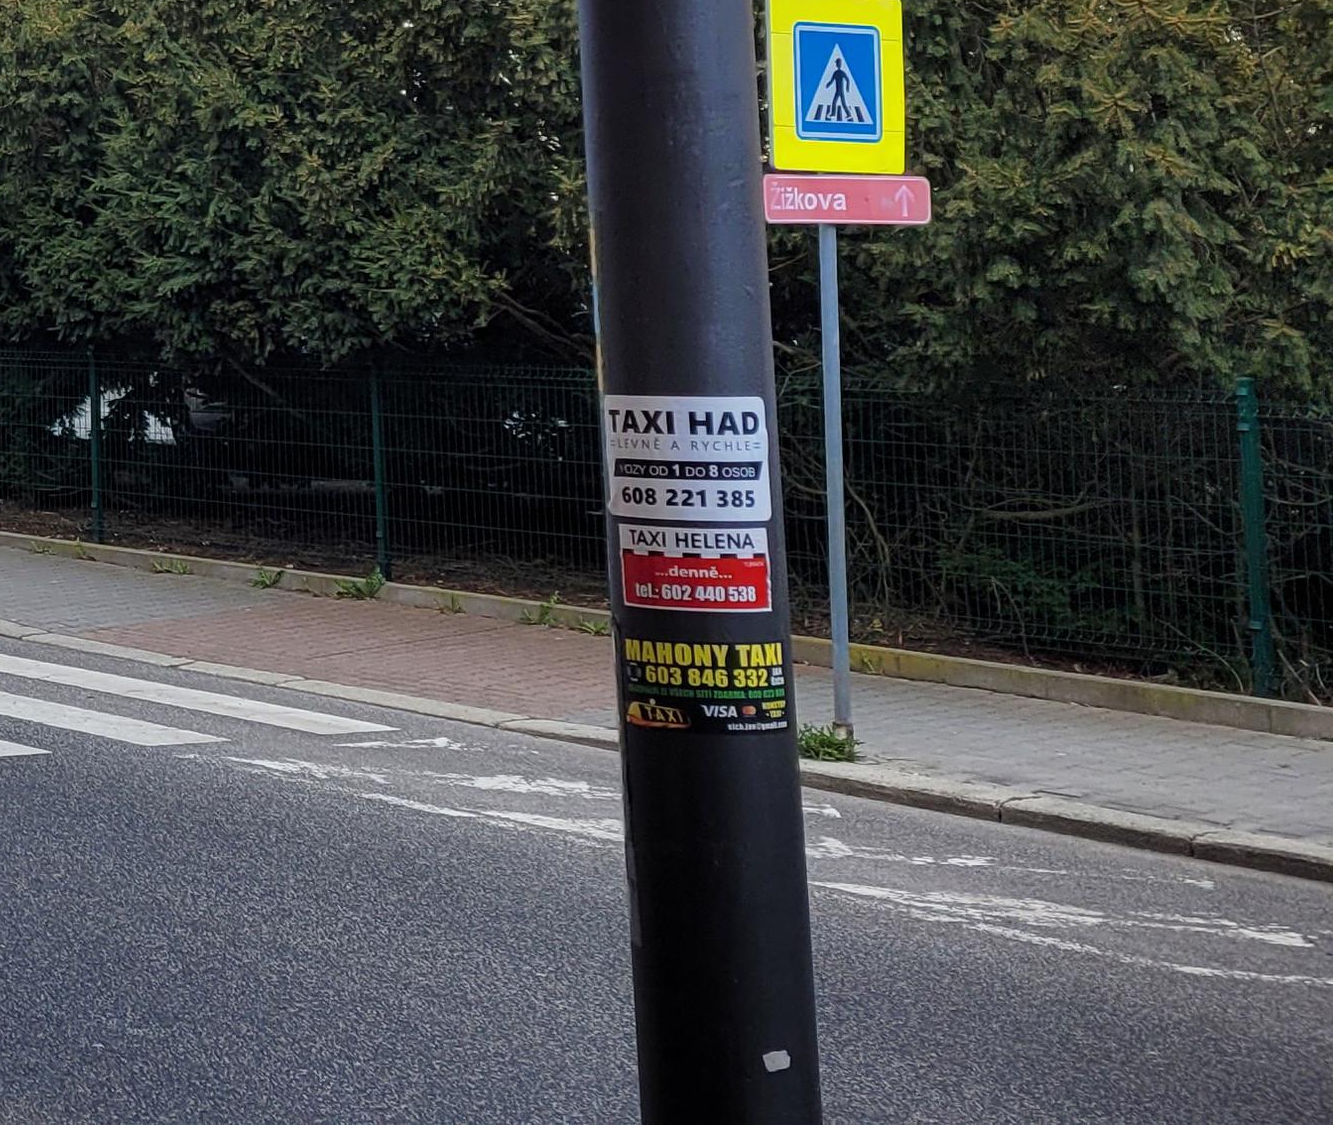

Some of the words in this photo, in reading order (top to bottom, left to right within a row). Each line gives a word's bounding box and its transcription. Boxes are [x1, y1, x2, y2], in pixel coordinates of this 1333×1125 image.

[608, 409, 676, 435] TAXI
[688, 411, 760, 436] HAD
[670, 440, 680, 450] A
[648, 464, 668, 476] OD
[672, 464, 680, 477] 1
[685, 466, 706, 477] DO
[708, 464, 719, 477] 8
[721, 466, 756, 477] OSOB
[621, 486, 657, 506] 608
[665, 489, 708, 507] 221
[716, 489, 755, 508] 385
[629, 529, 667, 548] TAXI
[675, 532, 755, 549] HELENA
[661, 584, 692, 601] 602
[694, 586, 725, 602] 440
[727, 586, 757, 603] 538
[624, 638, 729, 667] MAHONY
[734, 642, 783, 667] TAXI
[645, 665, 683, 686] 603
[687, 668, 729, 688] 846
[733, 668, 769, 688] 332
[644, 706, 684, 724] TAXI
[700, 704, 738, 718] VISA
